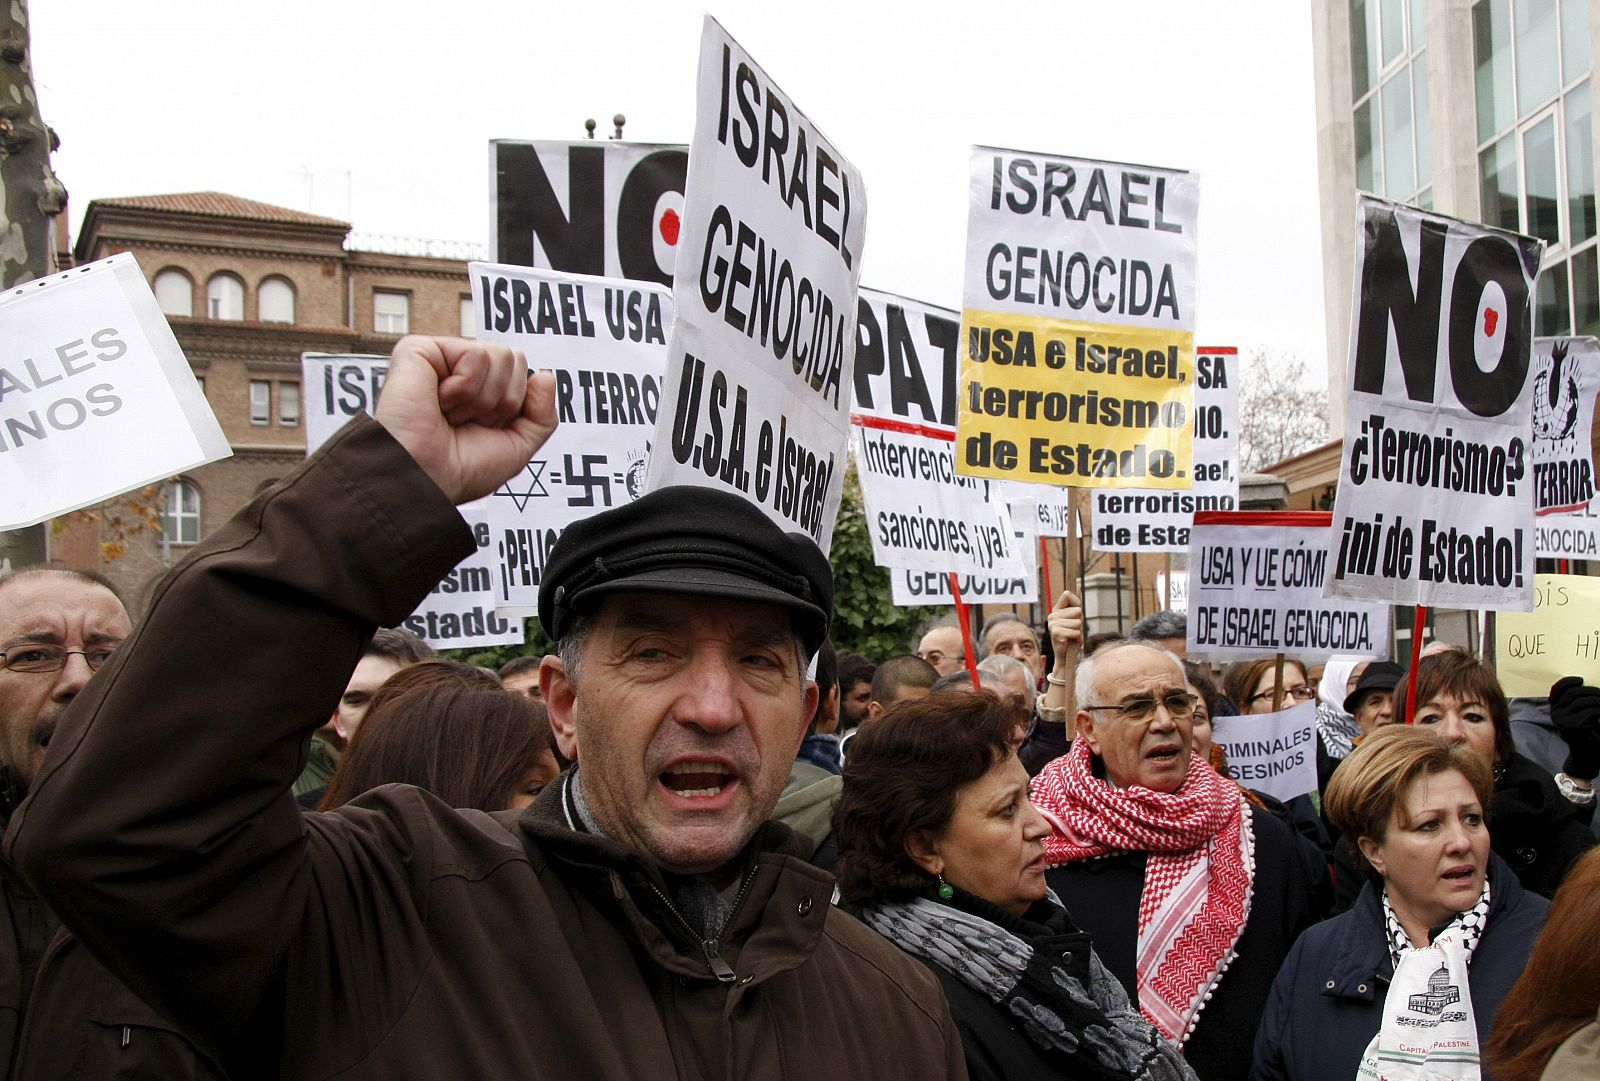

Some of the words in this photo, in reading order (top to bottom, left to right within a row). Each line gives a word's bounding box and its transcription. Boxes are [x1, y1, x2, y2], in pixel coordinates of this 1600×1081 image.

[718, 42, 852, 272] ISRAEL
[990, 155, 1183, 234] ISRAEL
[480, 275, 595, 338] ISRAEL
[604, 287, 666, 346] USA
[699, 203, 845, 411] GENOCIDA
[985, 242, 1180, 321] GENOCIDA
[1353, 217, 1532, 418] NO
[967, 326, 1037, 368] USA
[1045, 339, 1066, 370] e
[1075, 336, 1187, 384] Israel,
[578, 369, 664, 425] TERRO
[967, 381, 1186, 429] terrorismo
[671, 353, 750, 493] U.S.A.
[755, 419, 773, 503] e
[965, 431, 1018, 472] de
[1028, 437, 1186, 480] Estado.
[1350, 414, 1524, 498] ¿Terrorismo?
[1098, 491, 1235, 515] terrorismo
[1534, 457, 1594, 509] TERROR
[877, 505, 976, 565] sanciones,
[1097, 523, 1134, 546] de
[1335, 513, 1384, 581] ¡ni
[1385, 515, 1413, 580] de
[1418, 519, 1524, 588] Estado!
[1200, 546, 1235, 586] USA
[1241, 547, 1253, 586] Y
[1255, 549, 1279, 588] UE
[1196, 606, 1219, 645] DE
[1222, 607, 1280, 648] ISRAEL
[1284, 608, 1373, 651] GENOCIDA.
[1509, 633, 1546, 659] QUE
[1433, 1040, 1471, 1049] PALESTINE
